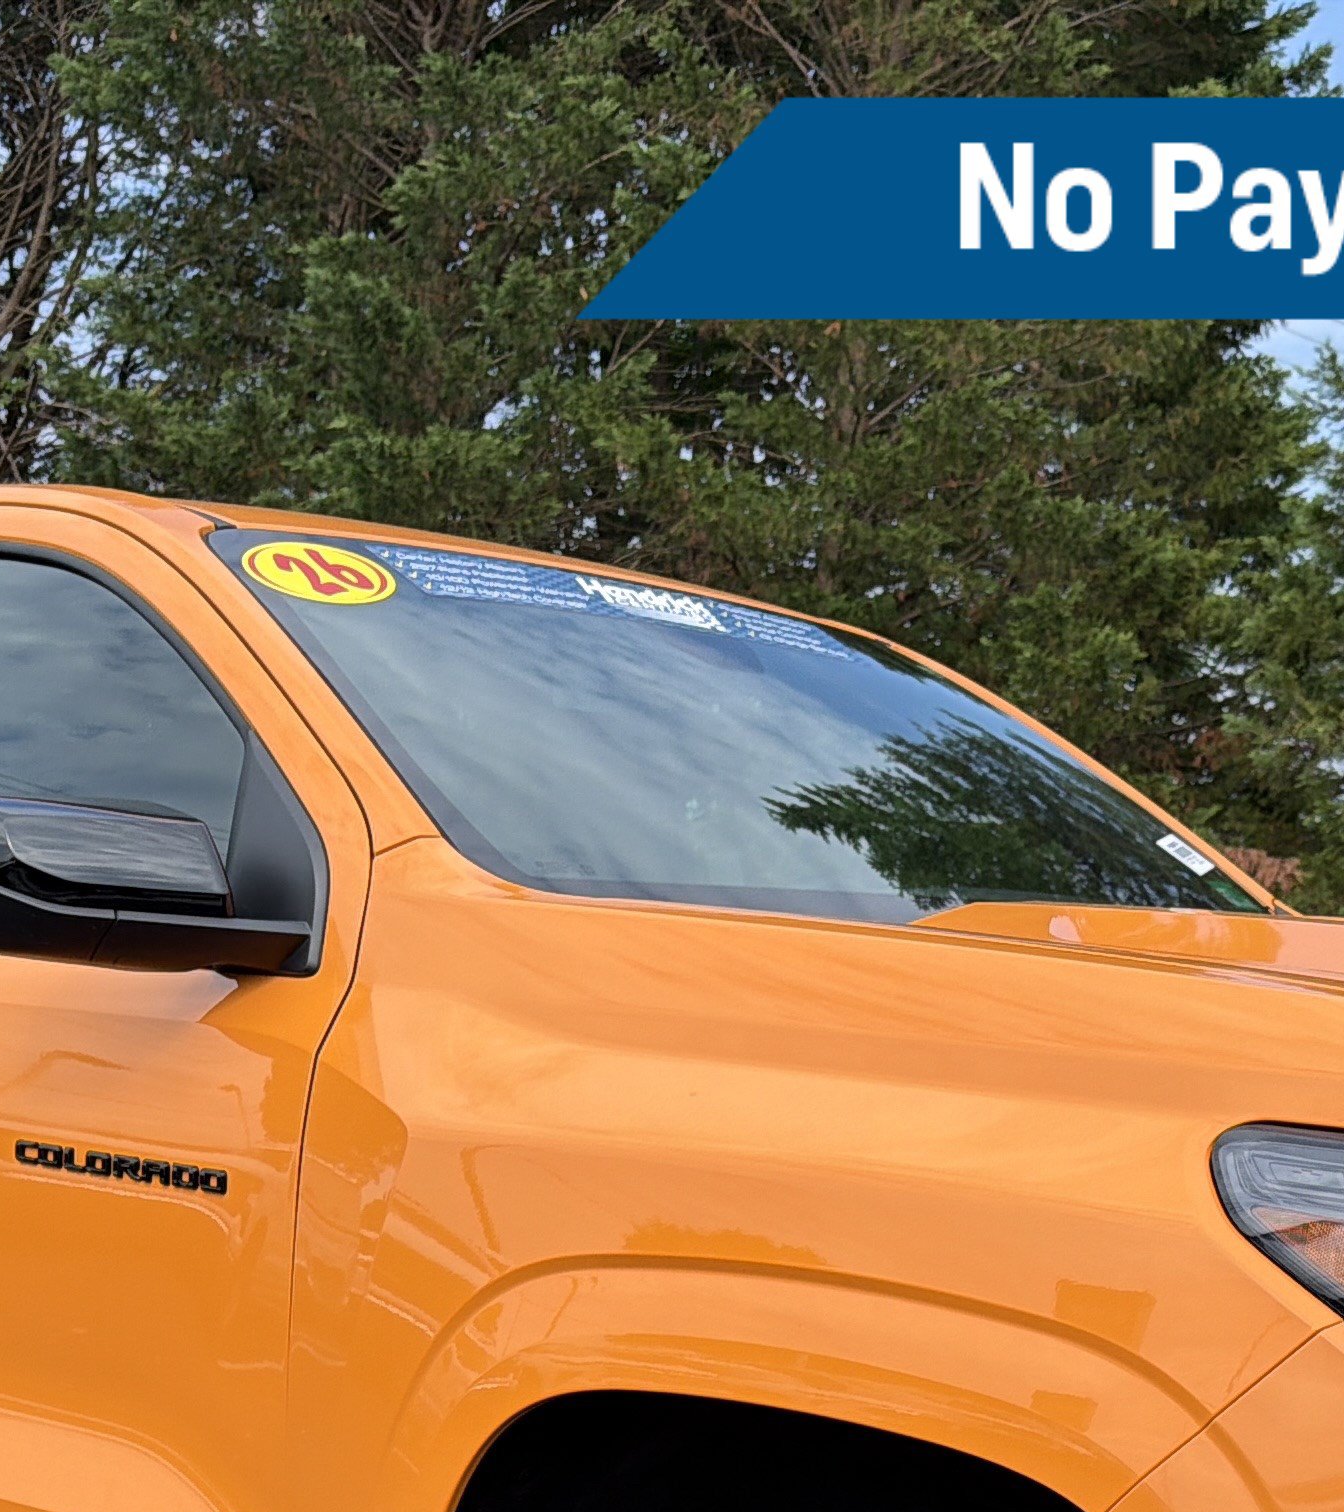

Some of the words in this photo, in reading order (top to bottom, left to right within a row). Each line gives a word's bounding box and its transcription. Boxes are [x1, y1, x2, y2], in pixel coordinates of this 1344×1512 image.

[272, 548, 375, 596] 26
[575, 575, 716, 618] Hendrick
[15, 1138, 228, 1196] COLORADO
